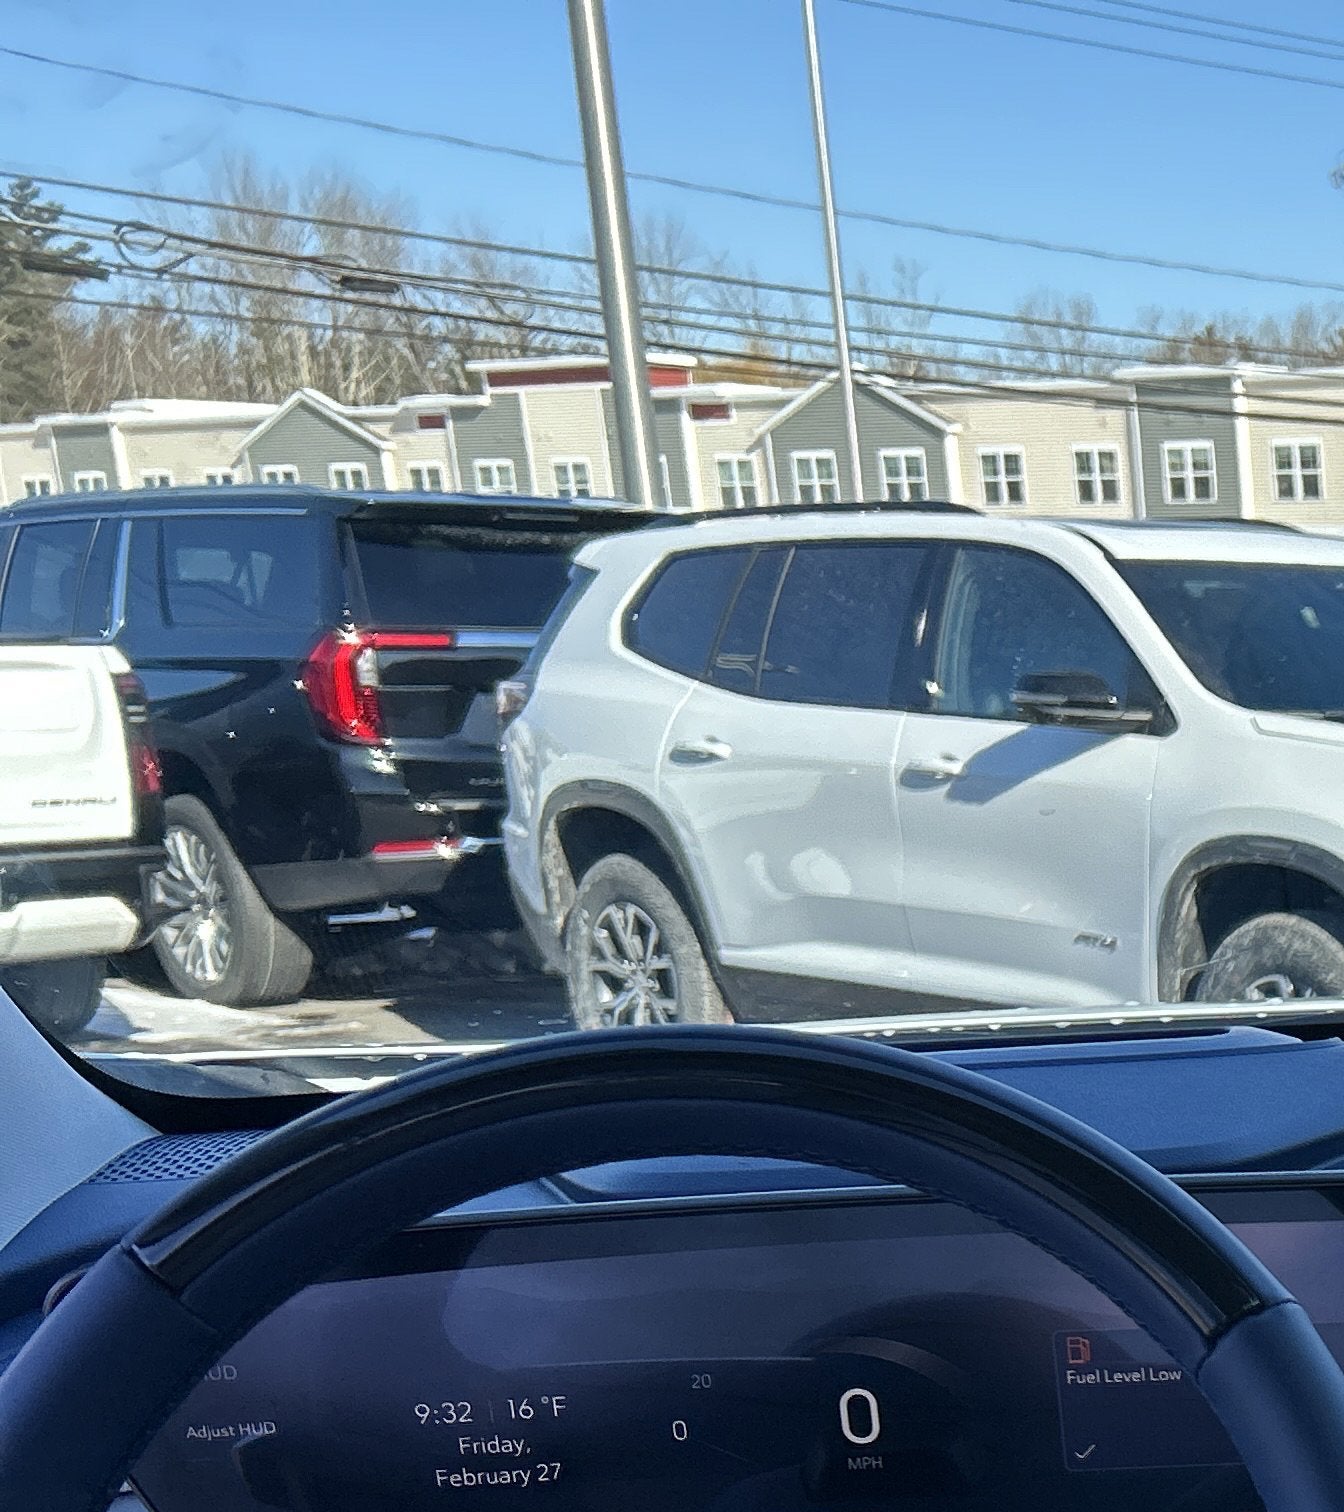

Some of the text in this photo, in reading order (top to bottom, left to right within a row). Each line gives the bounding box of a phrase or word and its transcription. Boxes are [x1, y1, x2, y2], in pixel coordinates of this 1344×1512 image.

[691, 1374, 712, 1389] 20
[1066, 1367, 1182, 1384] Fuel Level Low
[414, 1395, 567, 1425] 9:32 16 °F
[839, 1388, 881, 1445] 0
[186, 1421, 276, 1441] Adjust HUD
[672, 1420, 688, 1441] 0
[458, 1434, 531, 1457] Friday,
[847, 1456, 884, 1471] MPH
[434, 1462, 561, 1488] February 27
